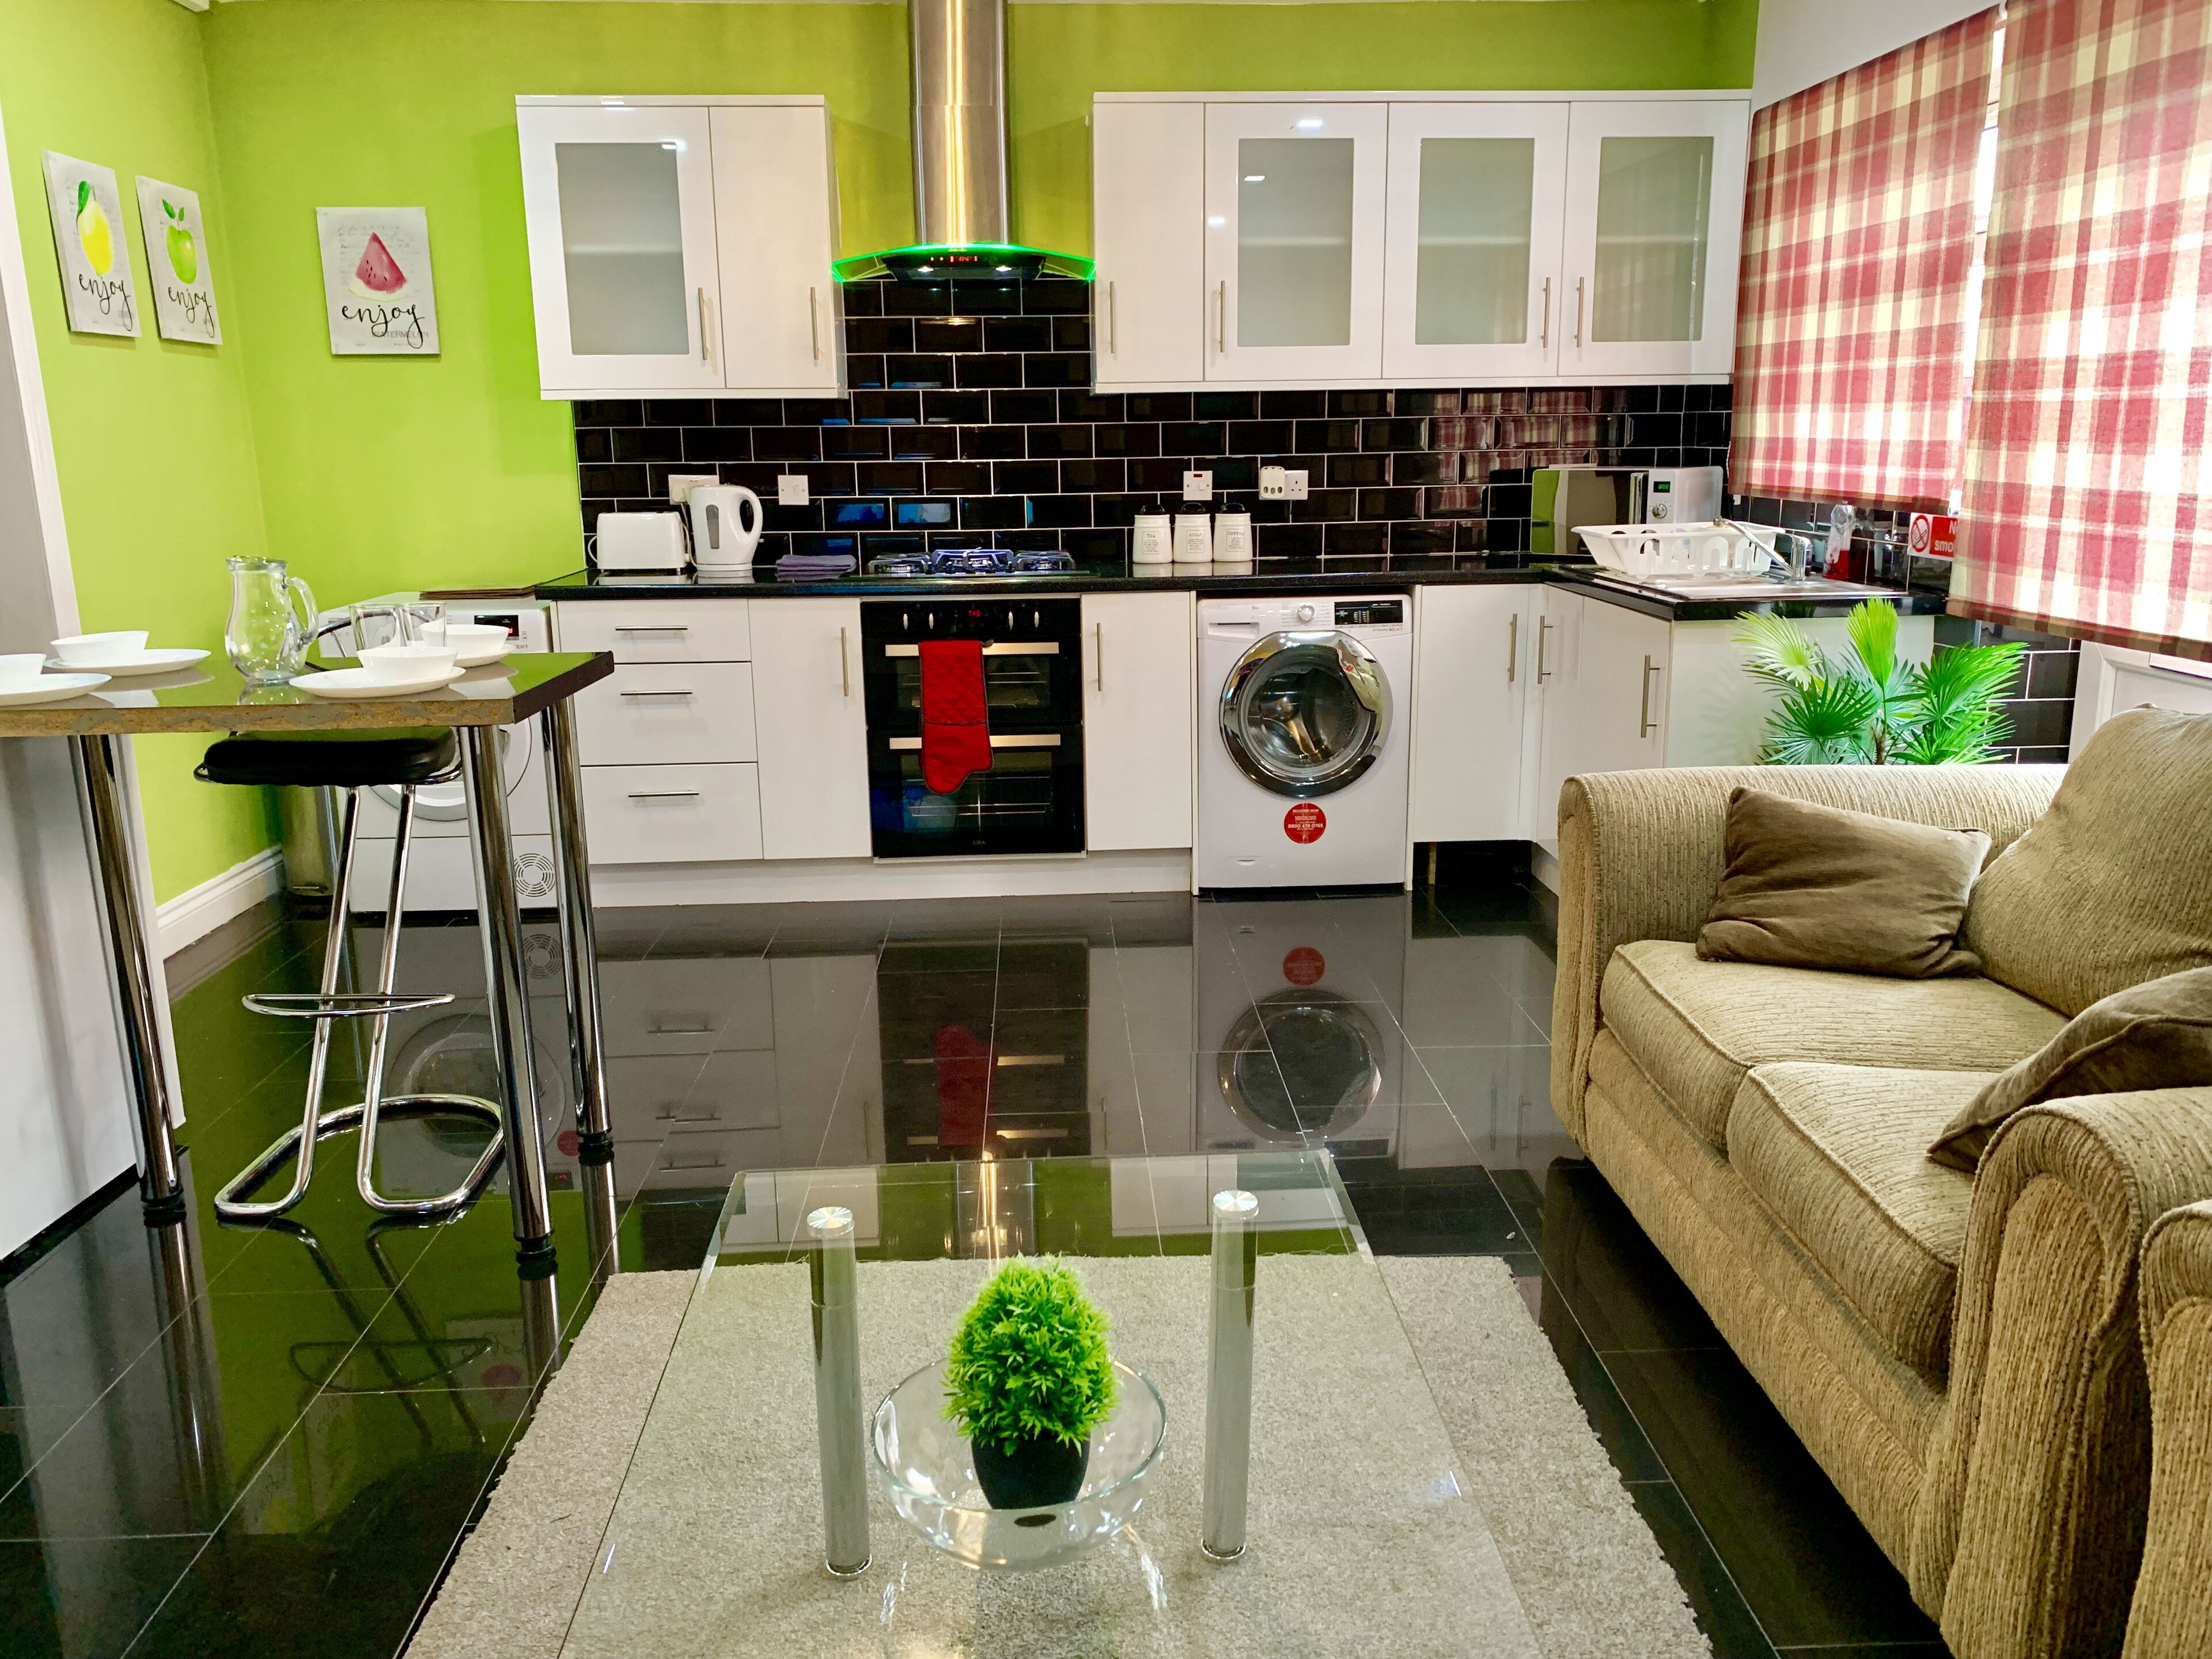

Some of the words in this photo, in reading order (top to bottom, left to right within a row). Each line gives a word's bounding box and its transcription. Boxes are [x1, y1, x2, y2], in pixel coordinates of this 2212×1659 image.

[79, 274, 132, 331] enjoy
[168, 287, 215, 338] enjoy
[342, 304, 425, 349] enjoy
